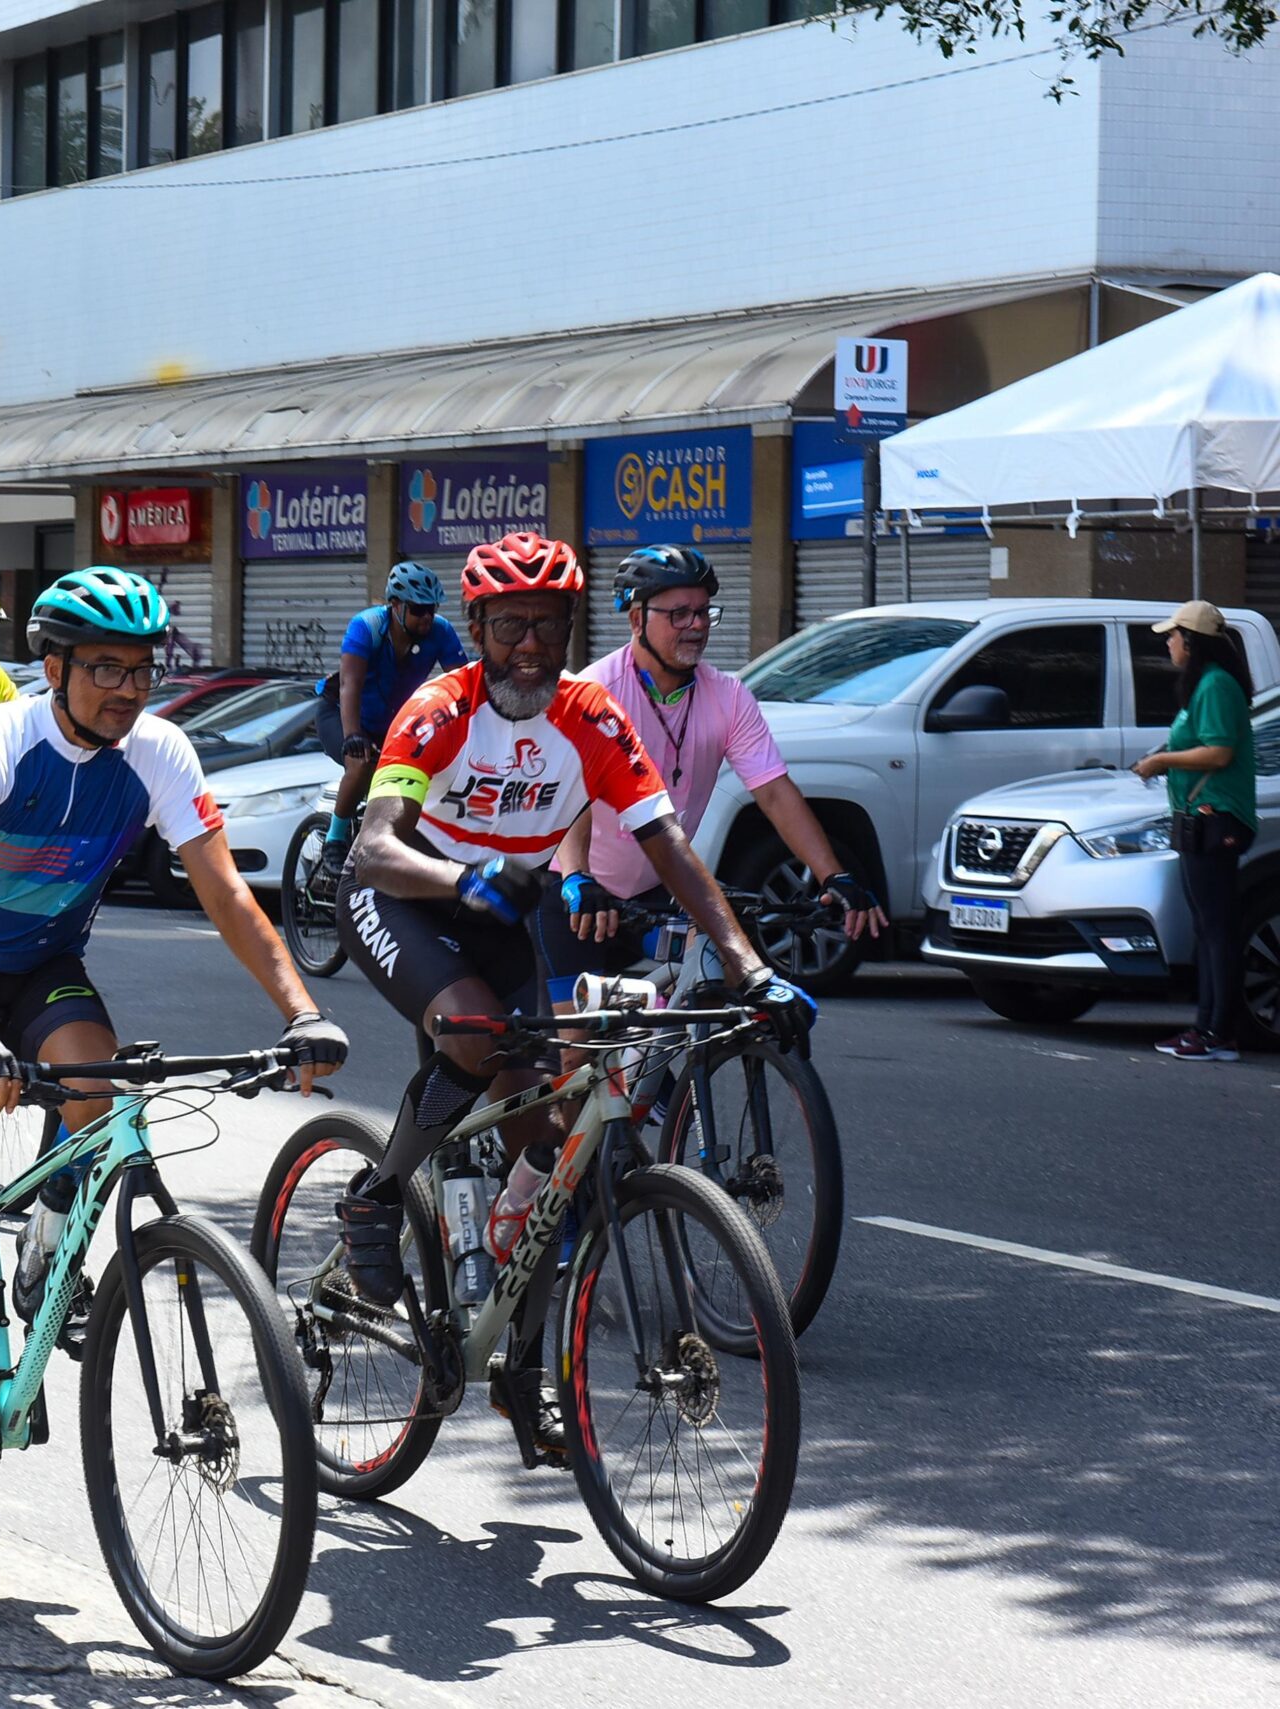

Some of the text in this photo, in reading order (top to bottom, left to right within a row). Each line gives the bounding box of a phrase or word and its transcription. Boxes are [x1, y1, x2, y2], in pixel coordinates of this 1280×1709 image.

[645, 445, 727, 466] SALVADOR
[274, 486, 366, 529] Lotérica
[441, 473, 547, 521] Lotérica
[647, 463, 727, 511] CASH
[128, 502, 185, 527] AMÉRICA
[437, 524, 487, 546] TERMINAL
[271, 529, 367, 552] TERMINAL DA FRANÇA
[348, 887, 401, 979] STRAVA
[506, 1165, 583, 1299] SENSE
